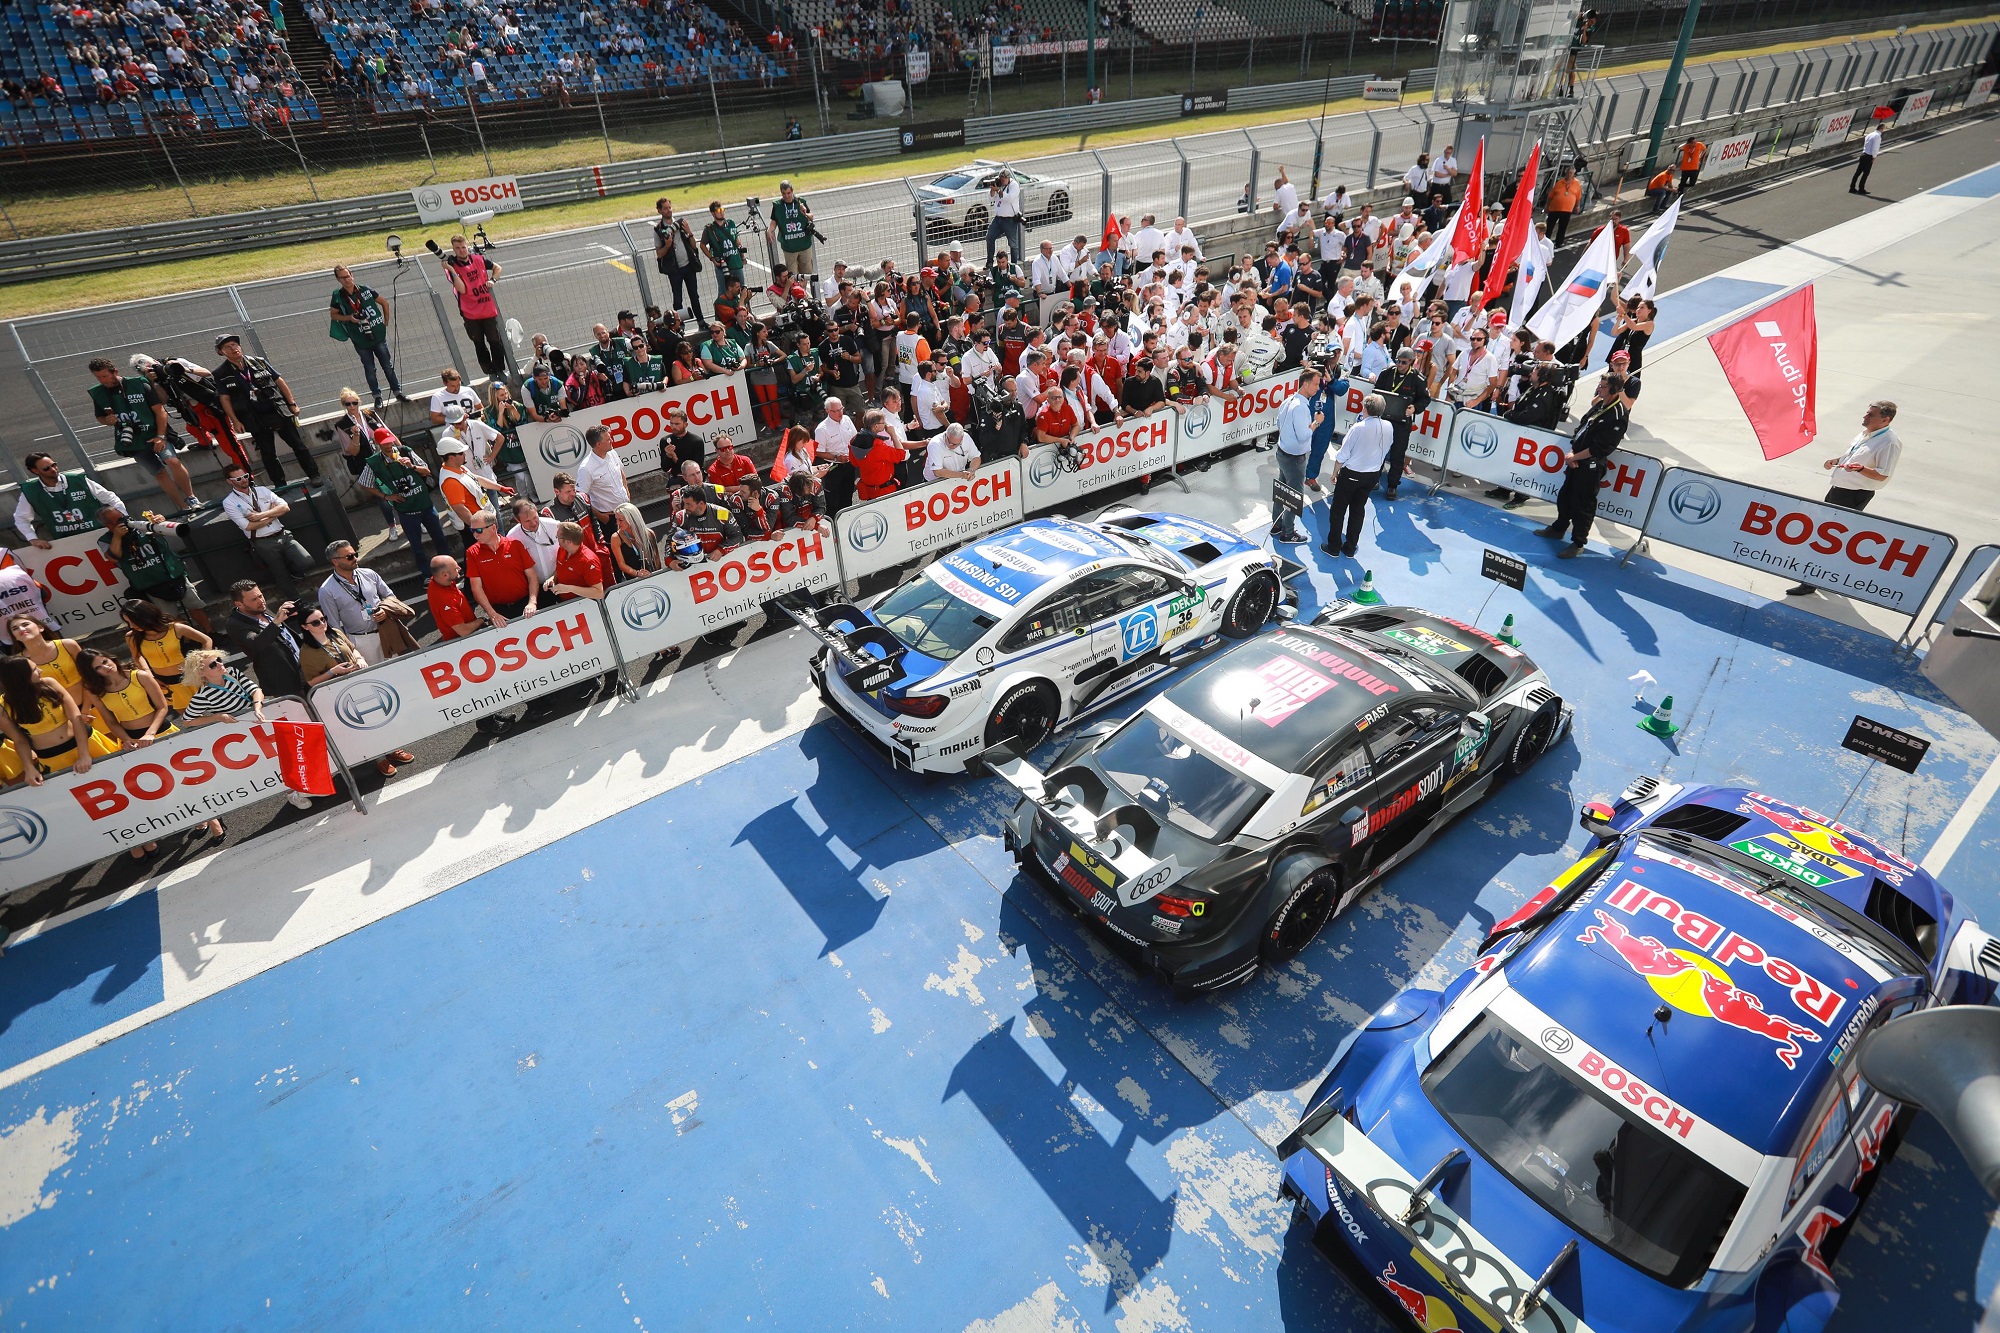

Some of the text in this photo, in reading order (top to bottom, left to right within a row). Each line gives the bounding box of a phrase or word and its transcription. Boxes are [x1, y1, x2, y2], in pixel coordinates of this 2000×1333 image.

[1910, 95, 1931, 112] BOSCH
[1827, 115, 1851, 133] BOSCH
[1721, 138, 1751, 161] BOSCH
[450, 182, 516, 206] BOSCH
[1770, 342, 1802, 383] Audi
[601, 385, 740, 449] BOSCH
[1223, 379, 1300, 424] BOSCH
[704, 422, 744, 445] Leben
[1078, 420, 1167, 470] BOSCH
[1221, 425, 1253, 442] Technik
[1254, 421, 1271, 435] fürs
[1077, 454, 1166, 489] Technik fürs Leben
[904, 469, 1012, 530] BOSCH
[1510, 472, 1633, 519] Technik eben
[55, 521, 94, 532] BUDAPEST
[908, 506, 1014, 552] Technik fürs Leben
[1739, 501, 1930, 578] BOSCH
[689, 533, 824, 604] BOSCH
[987, 545, 1037, 574] SAMSUNG
[1069, 566, 1093, 580] MARTIN
[1485, 552, 1525, 571] DMSB
[1732, 541, 1904, 604] Technik fürs Leben
[945, 556, 1021, 602] SAMSUNG SDI
[946, 580, 990, 607] BOSCH
[698, 571, 829, 628] Technik fürs Leben
[1178, 609, 1192, 624] 36
[1026, 629, 1043, 641] MAR
[1130, 620, 1150, 648] ZF
[1170, 622, 1191, 638] ADAC
[1393, 632, 1440, 655] DEKRA
[1427, 631, 1459, 646] ADAC
[419, 612, 594, 699] BOSCH
[438, 655, 601, 722] Technik fürs Leben
[863, 669, 890, 689] PUMA
[949, 684, 969, 697] H&R
[1366, 703, 1390, 724] RAST
[940, 736, 980, 756] MAHLE
[1189, 726, 1252, 767] BOSCH
[1851, 737, 1907, 763] parc fermé
[1854, 718, 1927, 752] DMSB
[69, 716, 289, 821] BOSCH
[295, 739, 309, 791] Audi Sport
[102, 770, 286, 845] Technik fürs Leb
[1749, 843, 1821, 887] DEKRA
[1787, 841, 1838, 868] ADAC
[1061, 864, 1118, 916] motorsport
[1570, 870, 1616, 913] EKSTRÖM
[1669, 857, 1800, 922] BOSCH
[1151, 921, 1181, 935] EDGE
[1839, 994, 1880, 1053] EKSTRÖM
[1578, 1051, 1696, 1139] BOSCH
